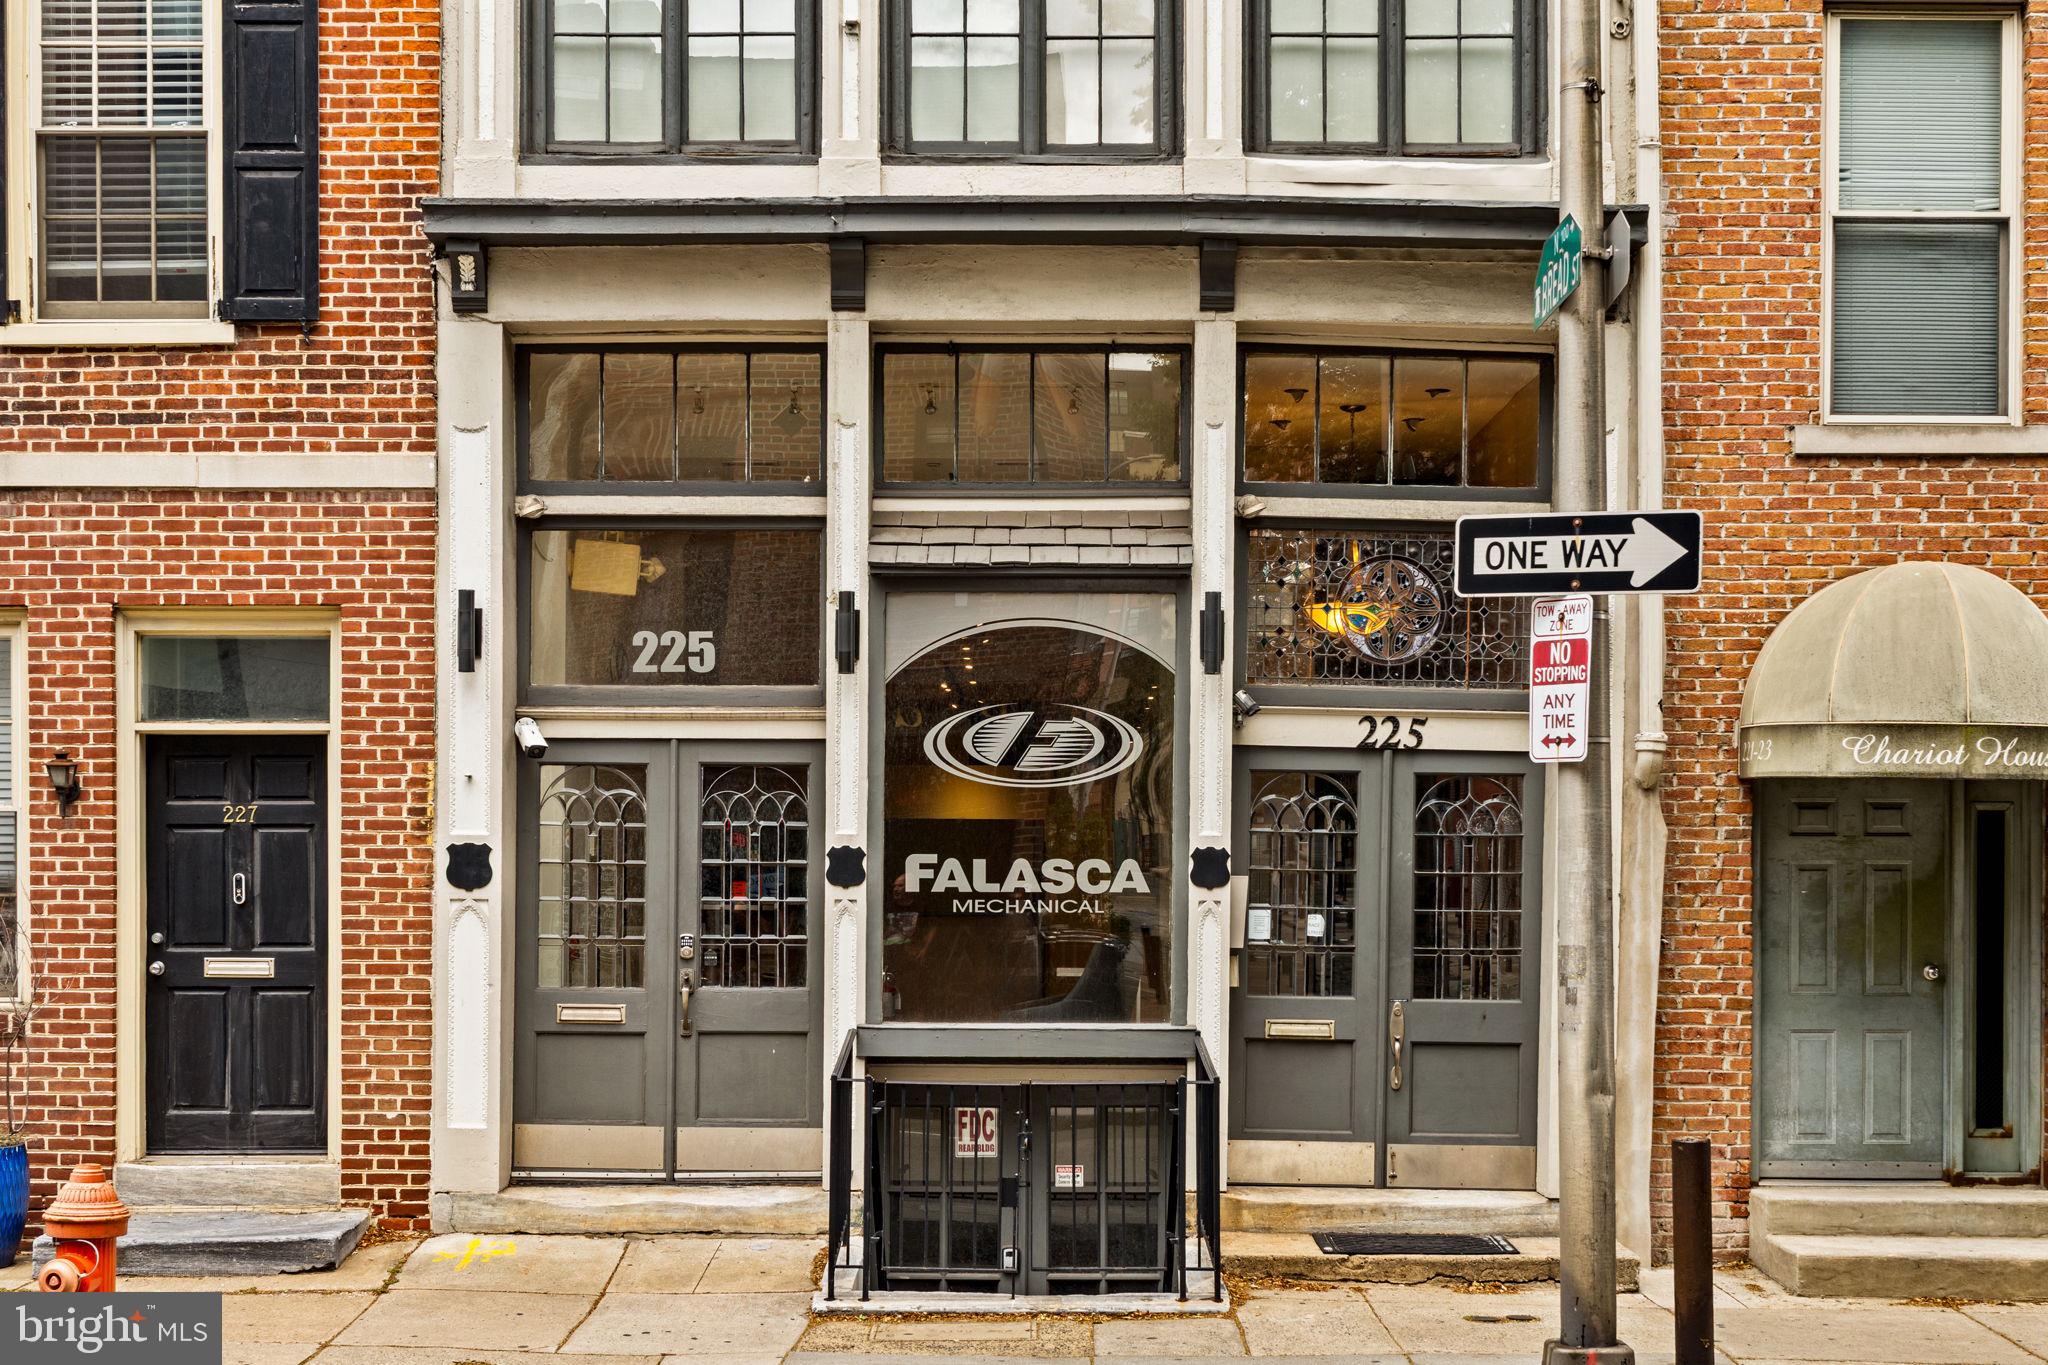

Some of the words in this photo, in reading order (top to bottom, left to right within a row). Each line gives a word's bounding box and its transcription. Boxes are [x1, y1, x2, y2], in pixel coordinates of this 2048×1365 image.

[1542, 251, 1569, 318] BREAD
[1485, 540, 1548, 570] ONE
[1561, 538, 1628, 569] WAY
[1549, 618, 1573, 632] ZONE
[632, 630, 716, 674] 225
[1550, 641, 1571, 665] NO
[1534, 664, 1586, 683] STOPPING
[1543, 693, 1576, 709] ANY
[1355, 715, 1429, 750] 225
[1542, 714, 1575, 729] TIME
[1842, 734, 1970, 766] Chariot
[222, 805, 259, 823] 227
[905, 853, 1151, 895] FALASCA
[952, 899, 1105, 914] MECHANICAL
[958, 1110, 995, 1142] FDC
